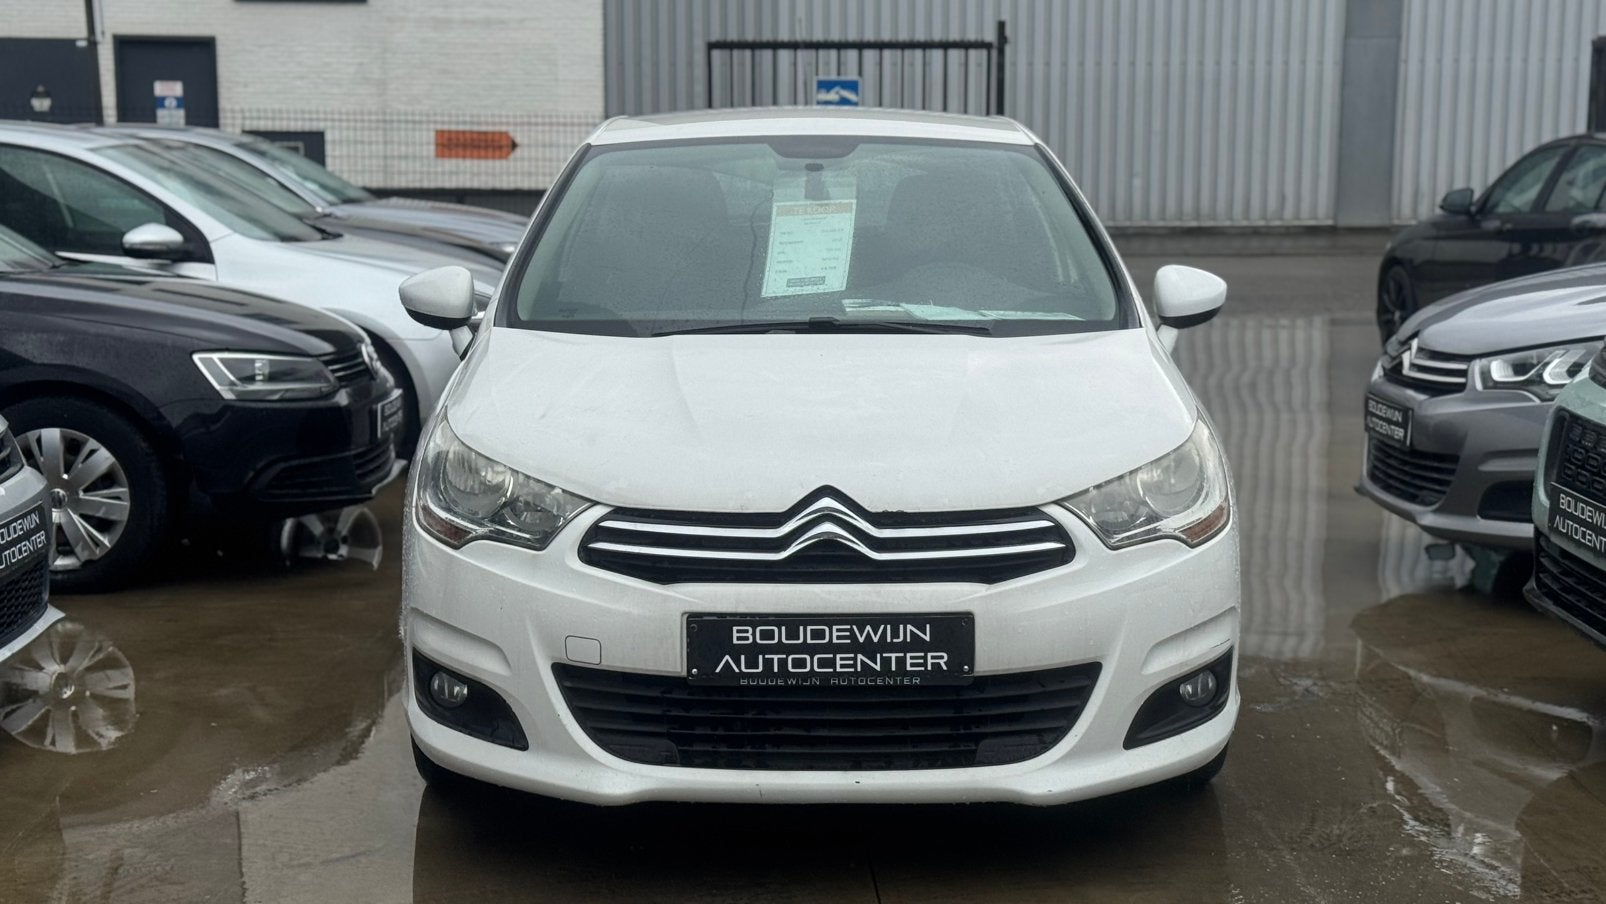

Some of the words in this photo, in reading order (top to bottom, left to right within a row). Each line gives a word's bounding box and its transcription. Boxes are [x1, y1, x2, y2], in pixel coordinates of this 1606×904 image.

[731, 623, 931, 645] BOUDEWIJN
[714, 652, 948, 673] AUTOCENTER
[830, 676, 921, 685] AUTOCENTER
